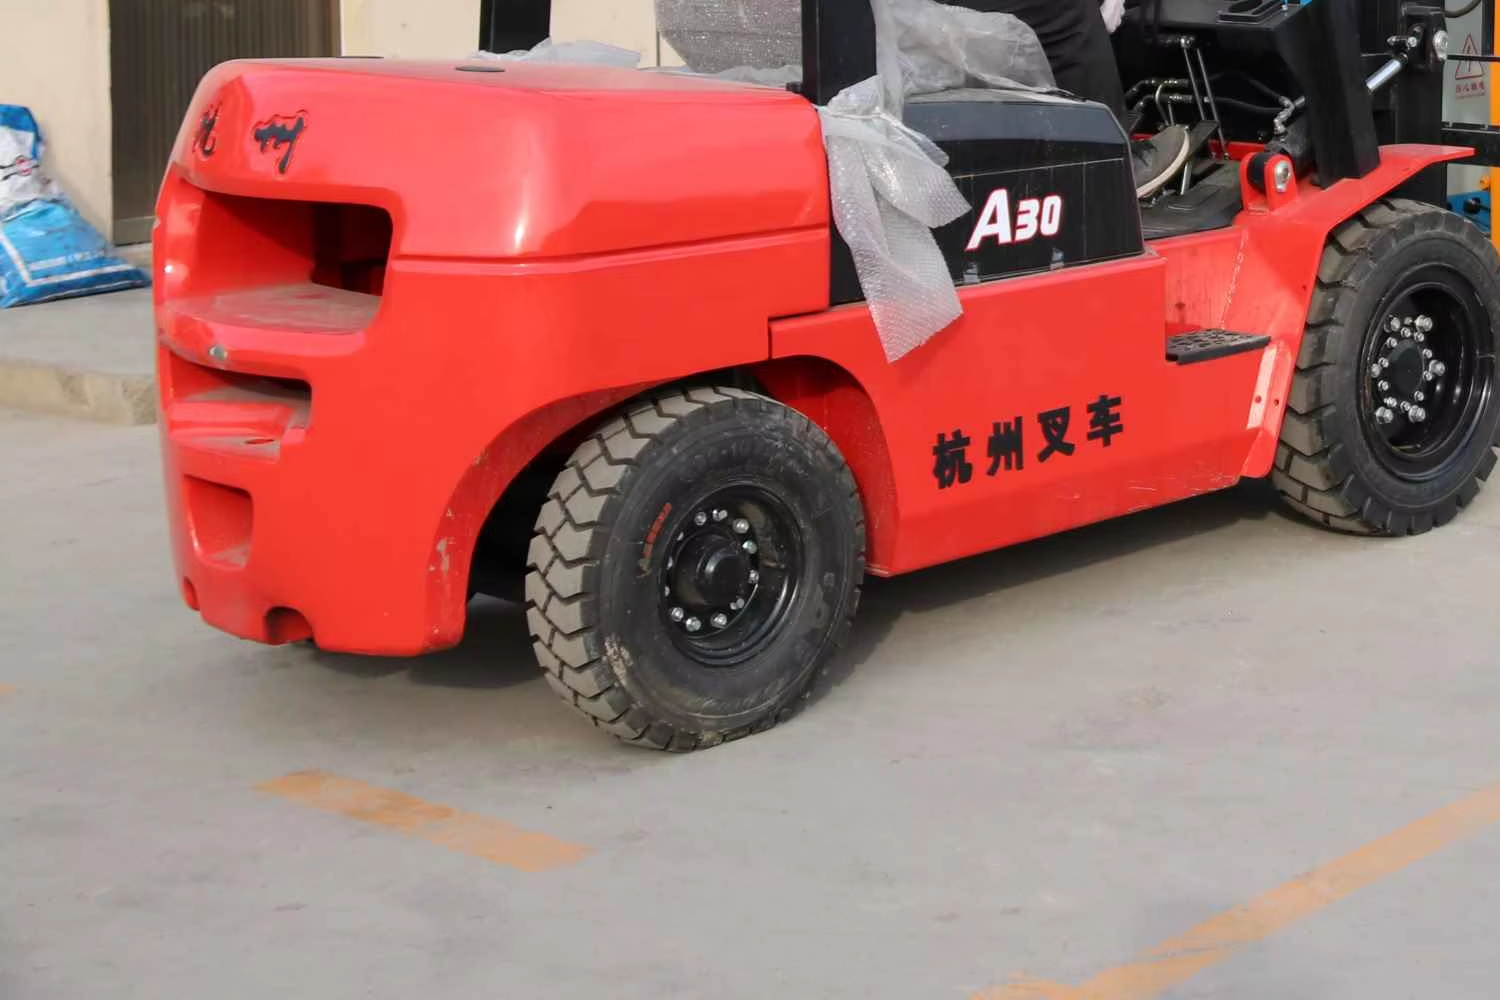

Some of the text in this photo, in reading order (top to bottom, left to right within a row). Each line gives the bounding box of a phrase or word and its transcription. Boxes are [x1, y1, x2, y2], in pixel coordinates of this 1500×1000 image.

[966, 188, 1062, 251] A30
[932, 394, 1124, 489] 杭州叉车
